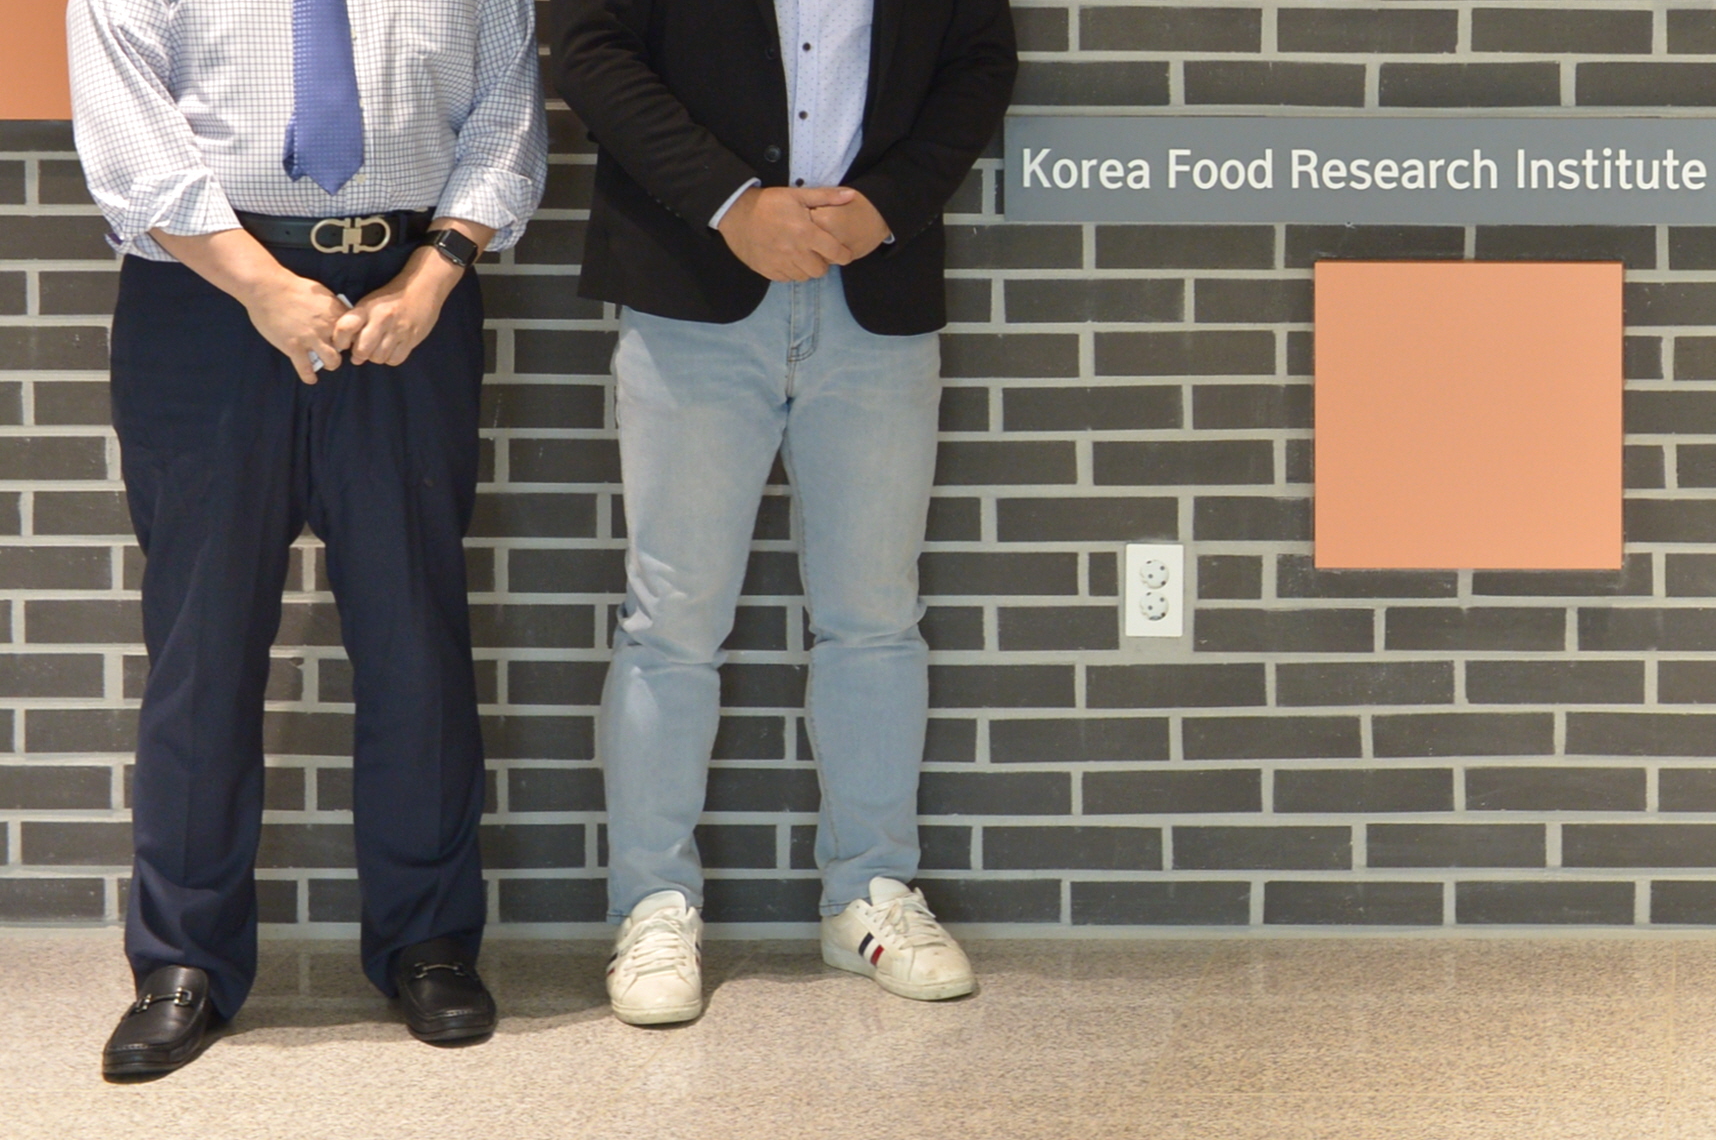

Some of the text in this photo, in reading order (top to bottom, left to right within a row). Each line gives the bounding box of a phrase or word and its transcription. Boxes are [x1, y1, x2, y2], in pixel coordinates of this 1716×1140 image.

[1022, 147, 1152, 191] Korea
[1166, 147, 1275, 191] Food
[1290, 147, 1499, 191] Research
[1516, 146, 1708, 192] Institute
